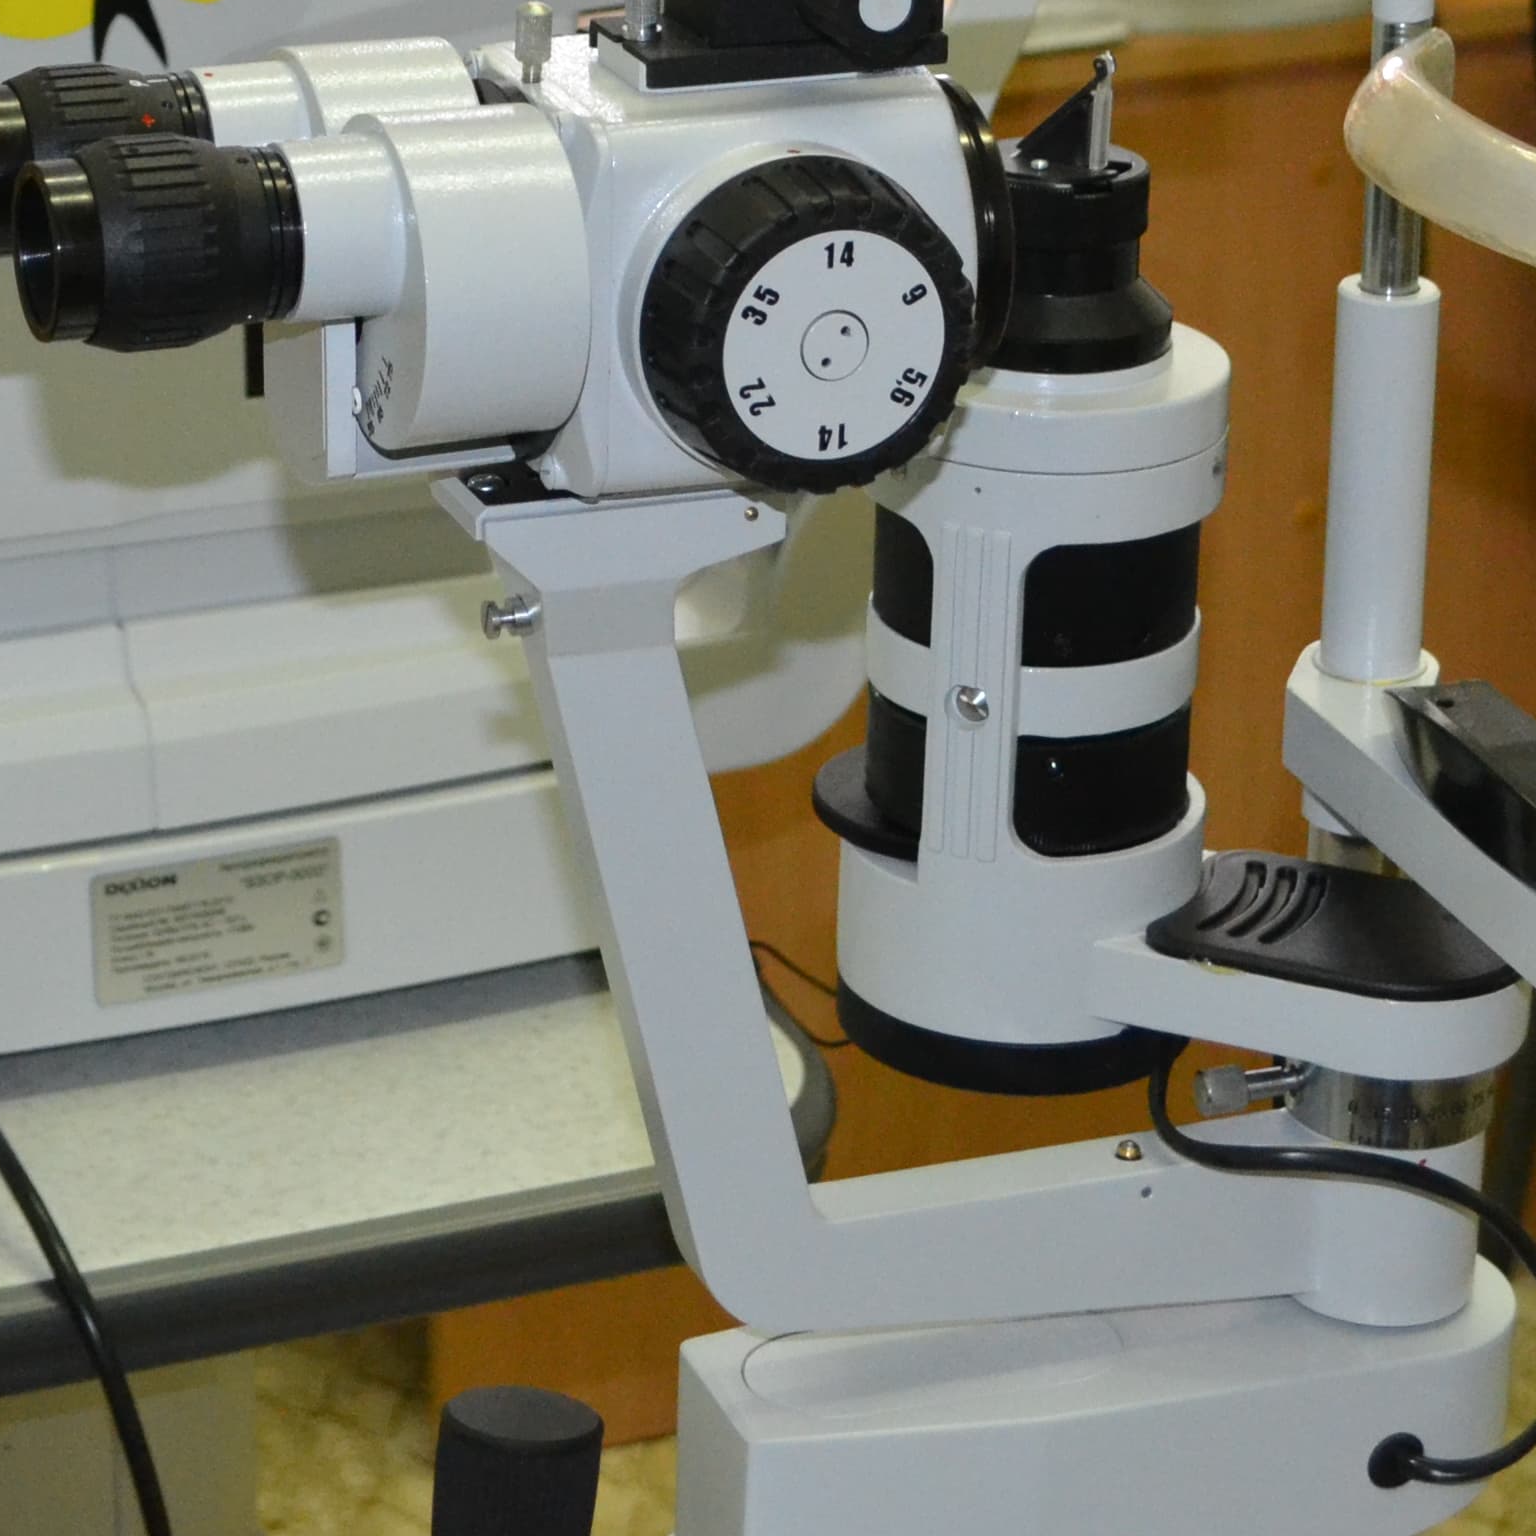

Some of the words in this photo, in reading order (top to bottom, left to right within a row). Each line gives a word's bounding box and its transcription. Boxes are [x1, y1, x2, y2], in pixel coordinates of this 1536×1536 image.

[824, 241, 854, 269] 14
[741, 284, 780, 326] 35
[901, 282, 928, 306] 9
[738, 377, 777, 417] 22
[818, 423, 848, 452] 14
